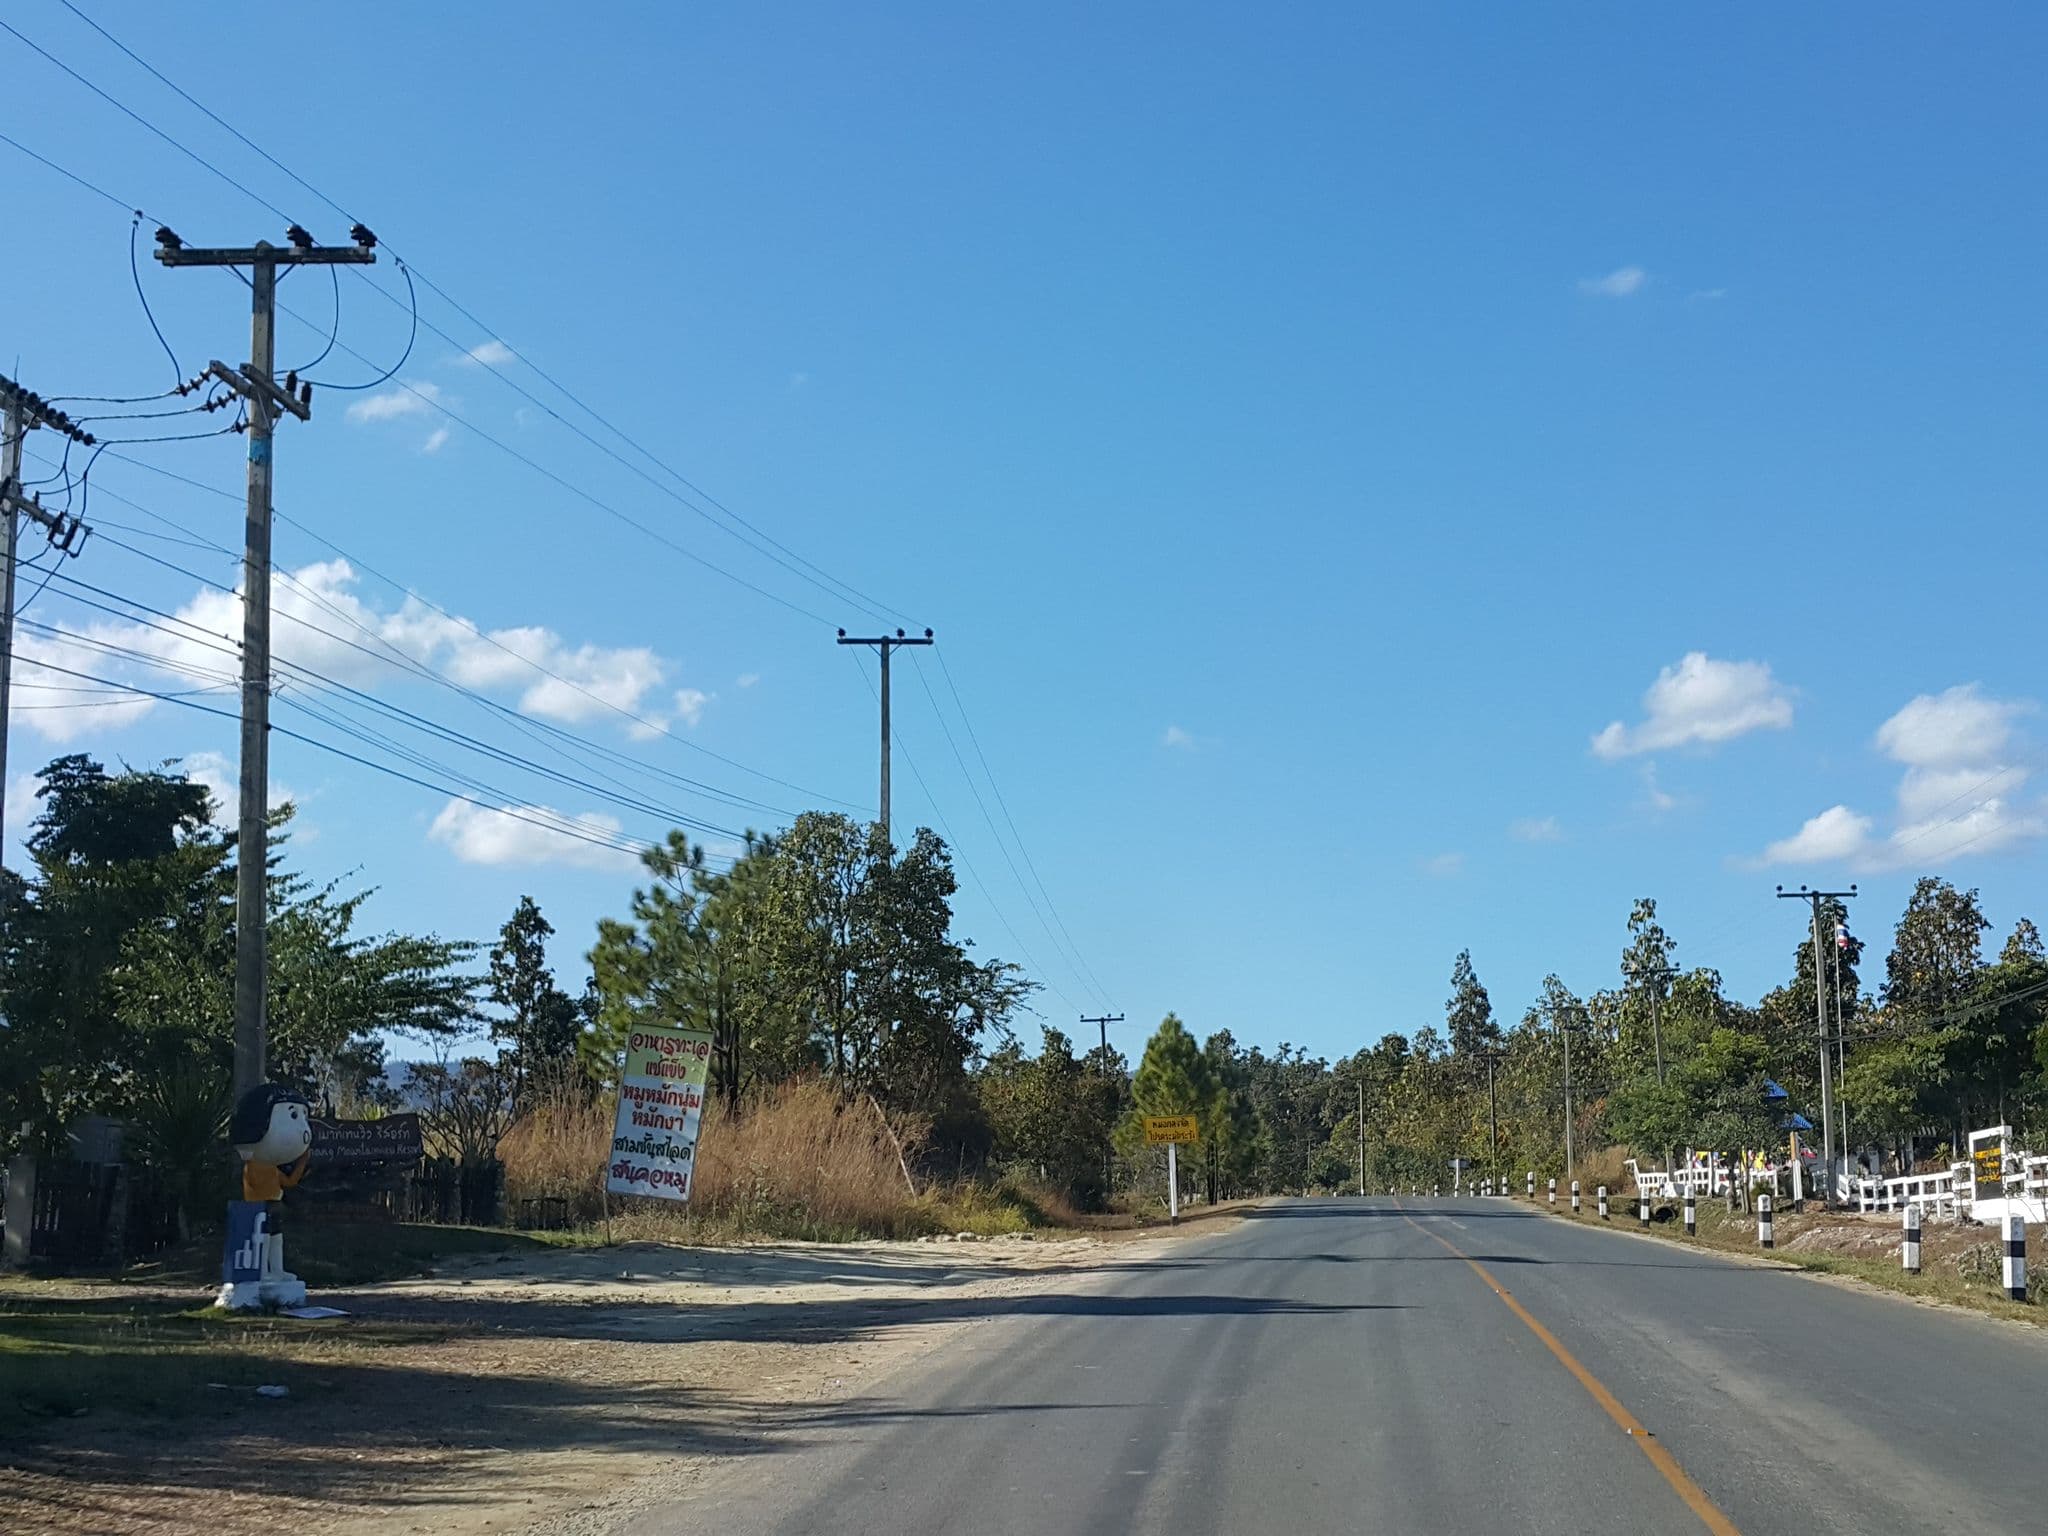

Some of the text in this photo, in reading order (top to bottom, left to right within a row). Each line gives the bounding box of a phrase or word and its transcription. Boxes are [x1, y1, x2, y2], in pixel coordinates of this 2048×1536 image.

[630, 1032, 709, 1061] อาหารทะเล
[645, 1055, 687, 1080] แช่แข็ง
[623, 1083, 700, 1115] หมูหมักนุ่ม
[631, 1106, 684, 1132] หมักงา
[614, 1132, 694, 1164] สามชั้นสไลด์
[611, 1159, 688, 1194] สันคอหมู
